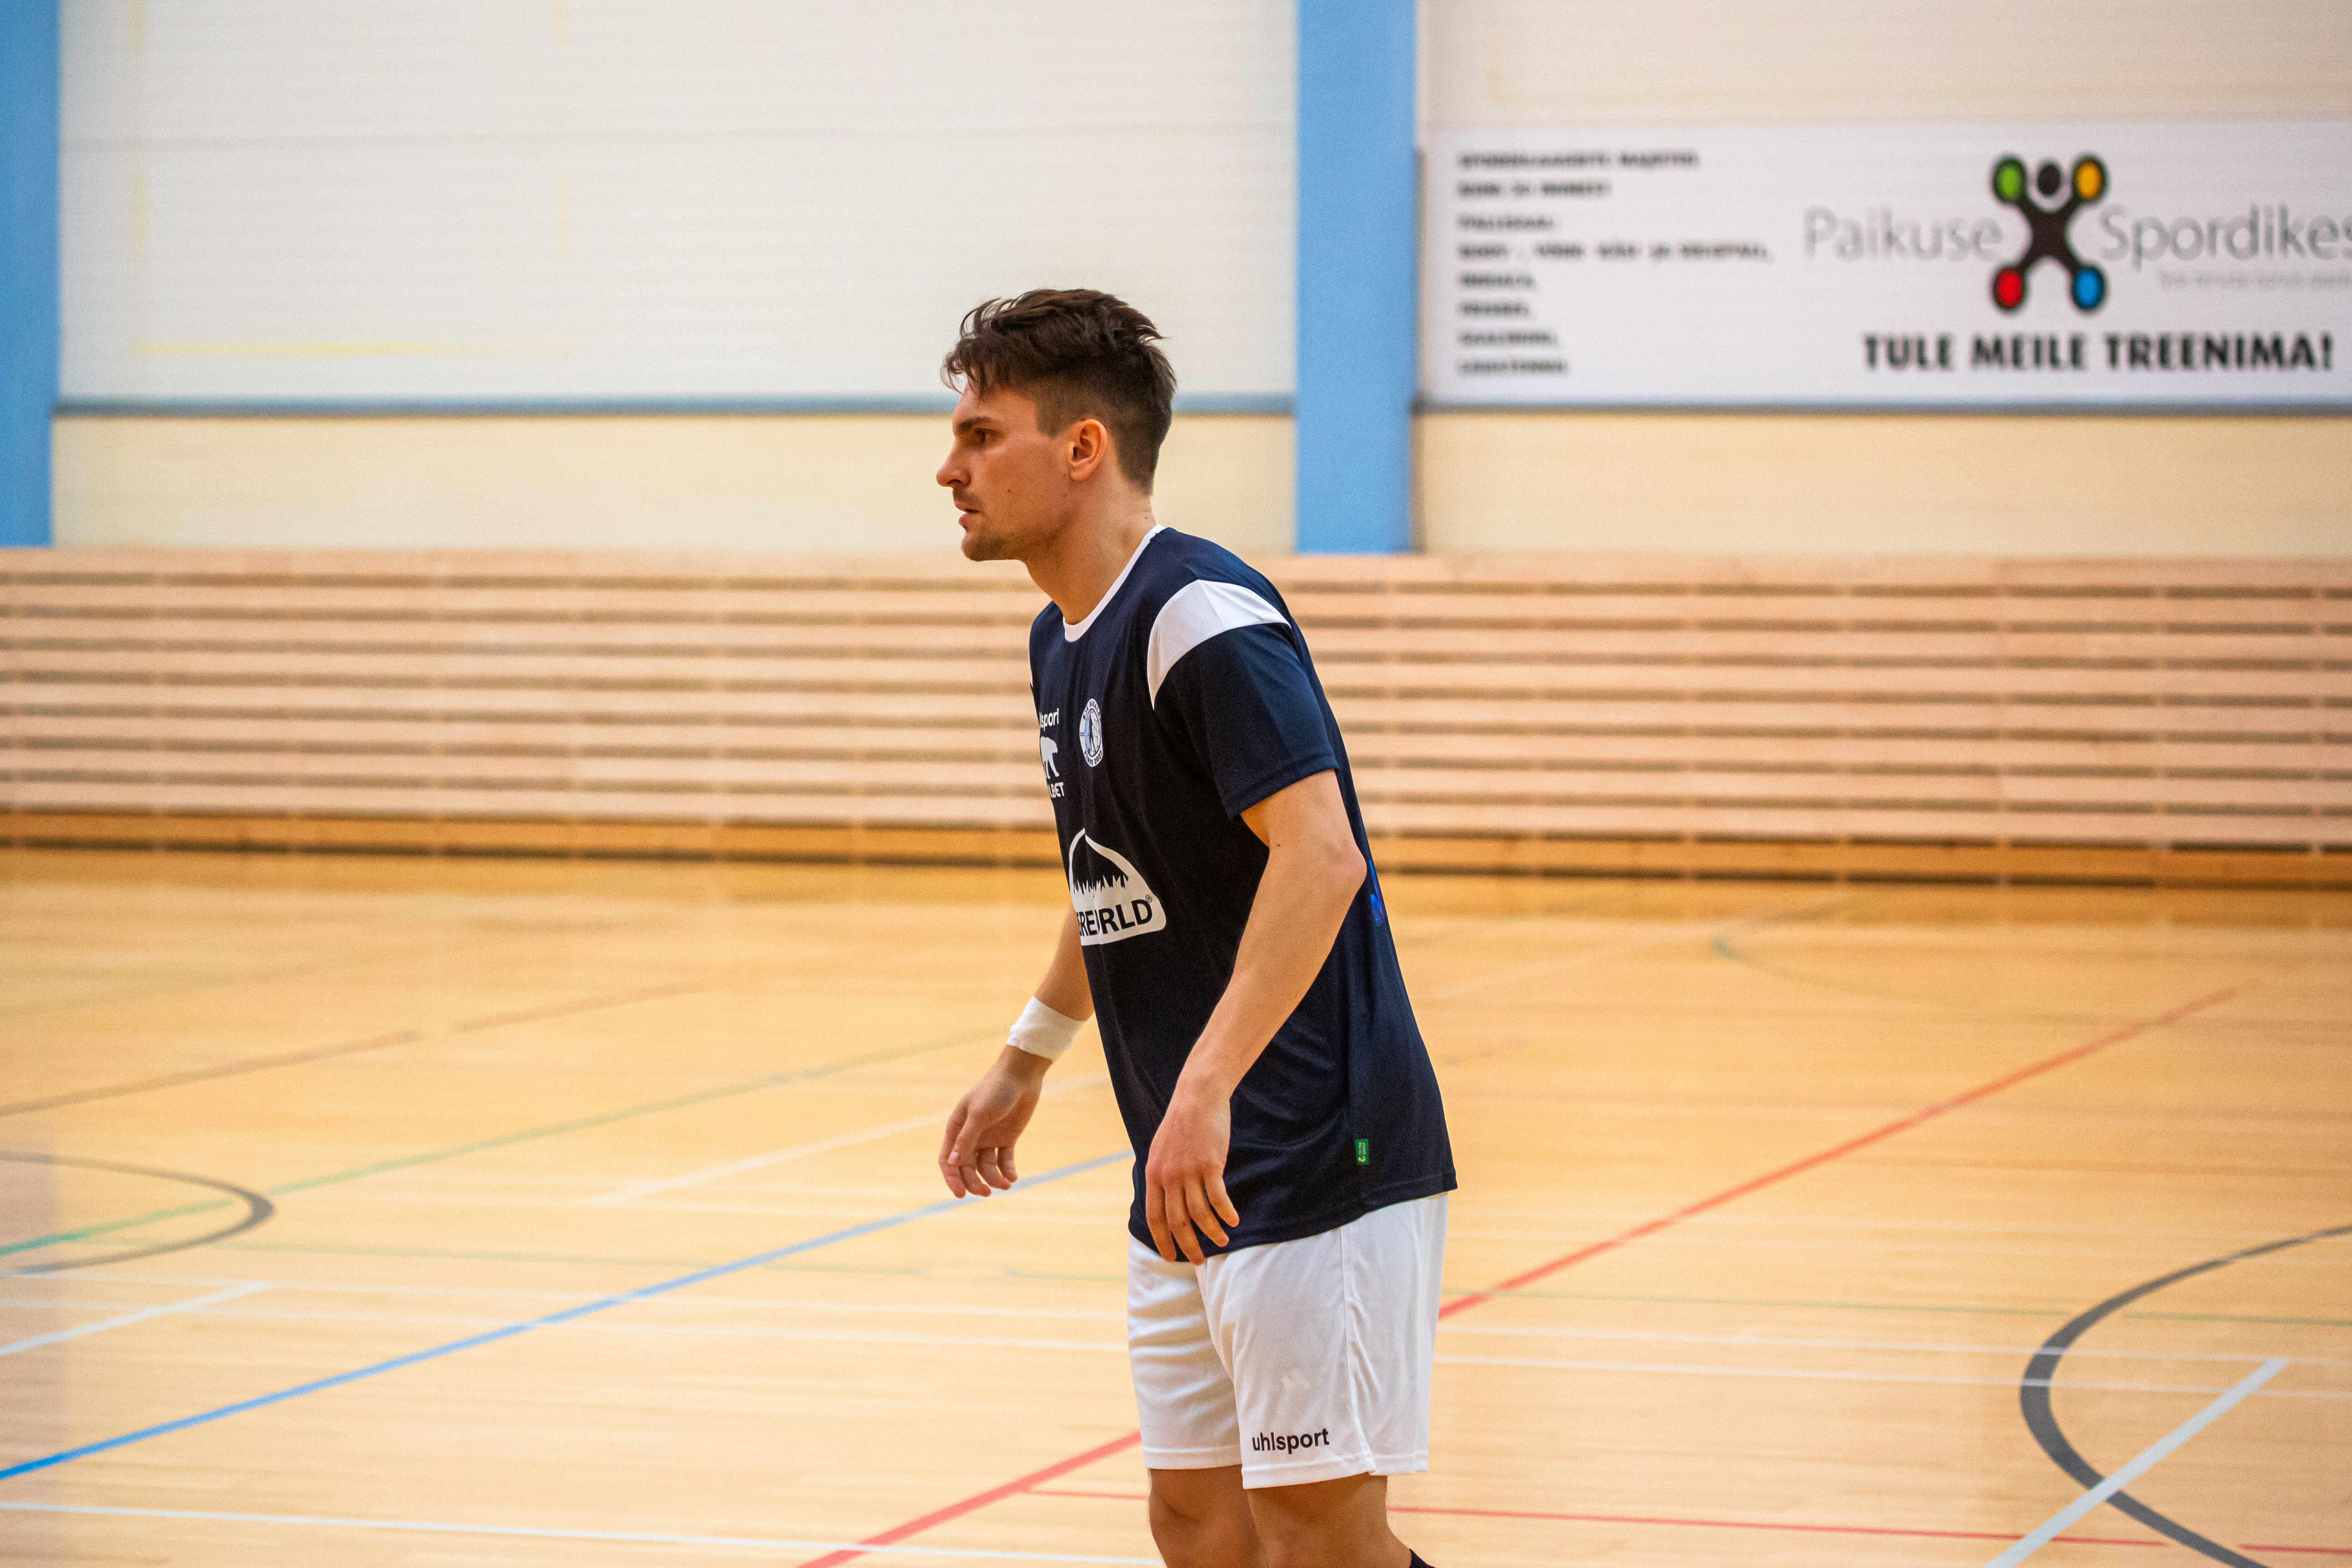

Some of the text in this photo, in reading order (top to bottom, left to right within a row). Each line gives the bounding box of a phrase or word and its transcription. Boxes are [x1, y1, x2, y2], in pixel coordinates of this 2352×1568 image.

[1803, 207, 2003, 262] Paikuse
[1862, 333, 2334, 370] TULE MEILE TREENIMA!
[1252, 1428, 1329, 1455] uhlsport
